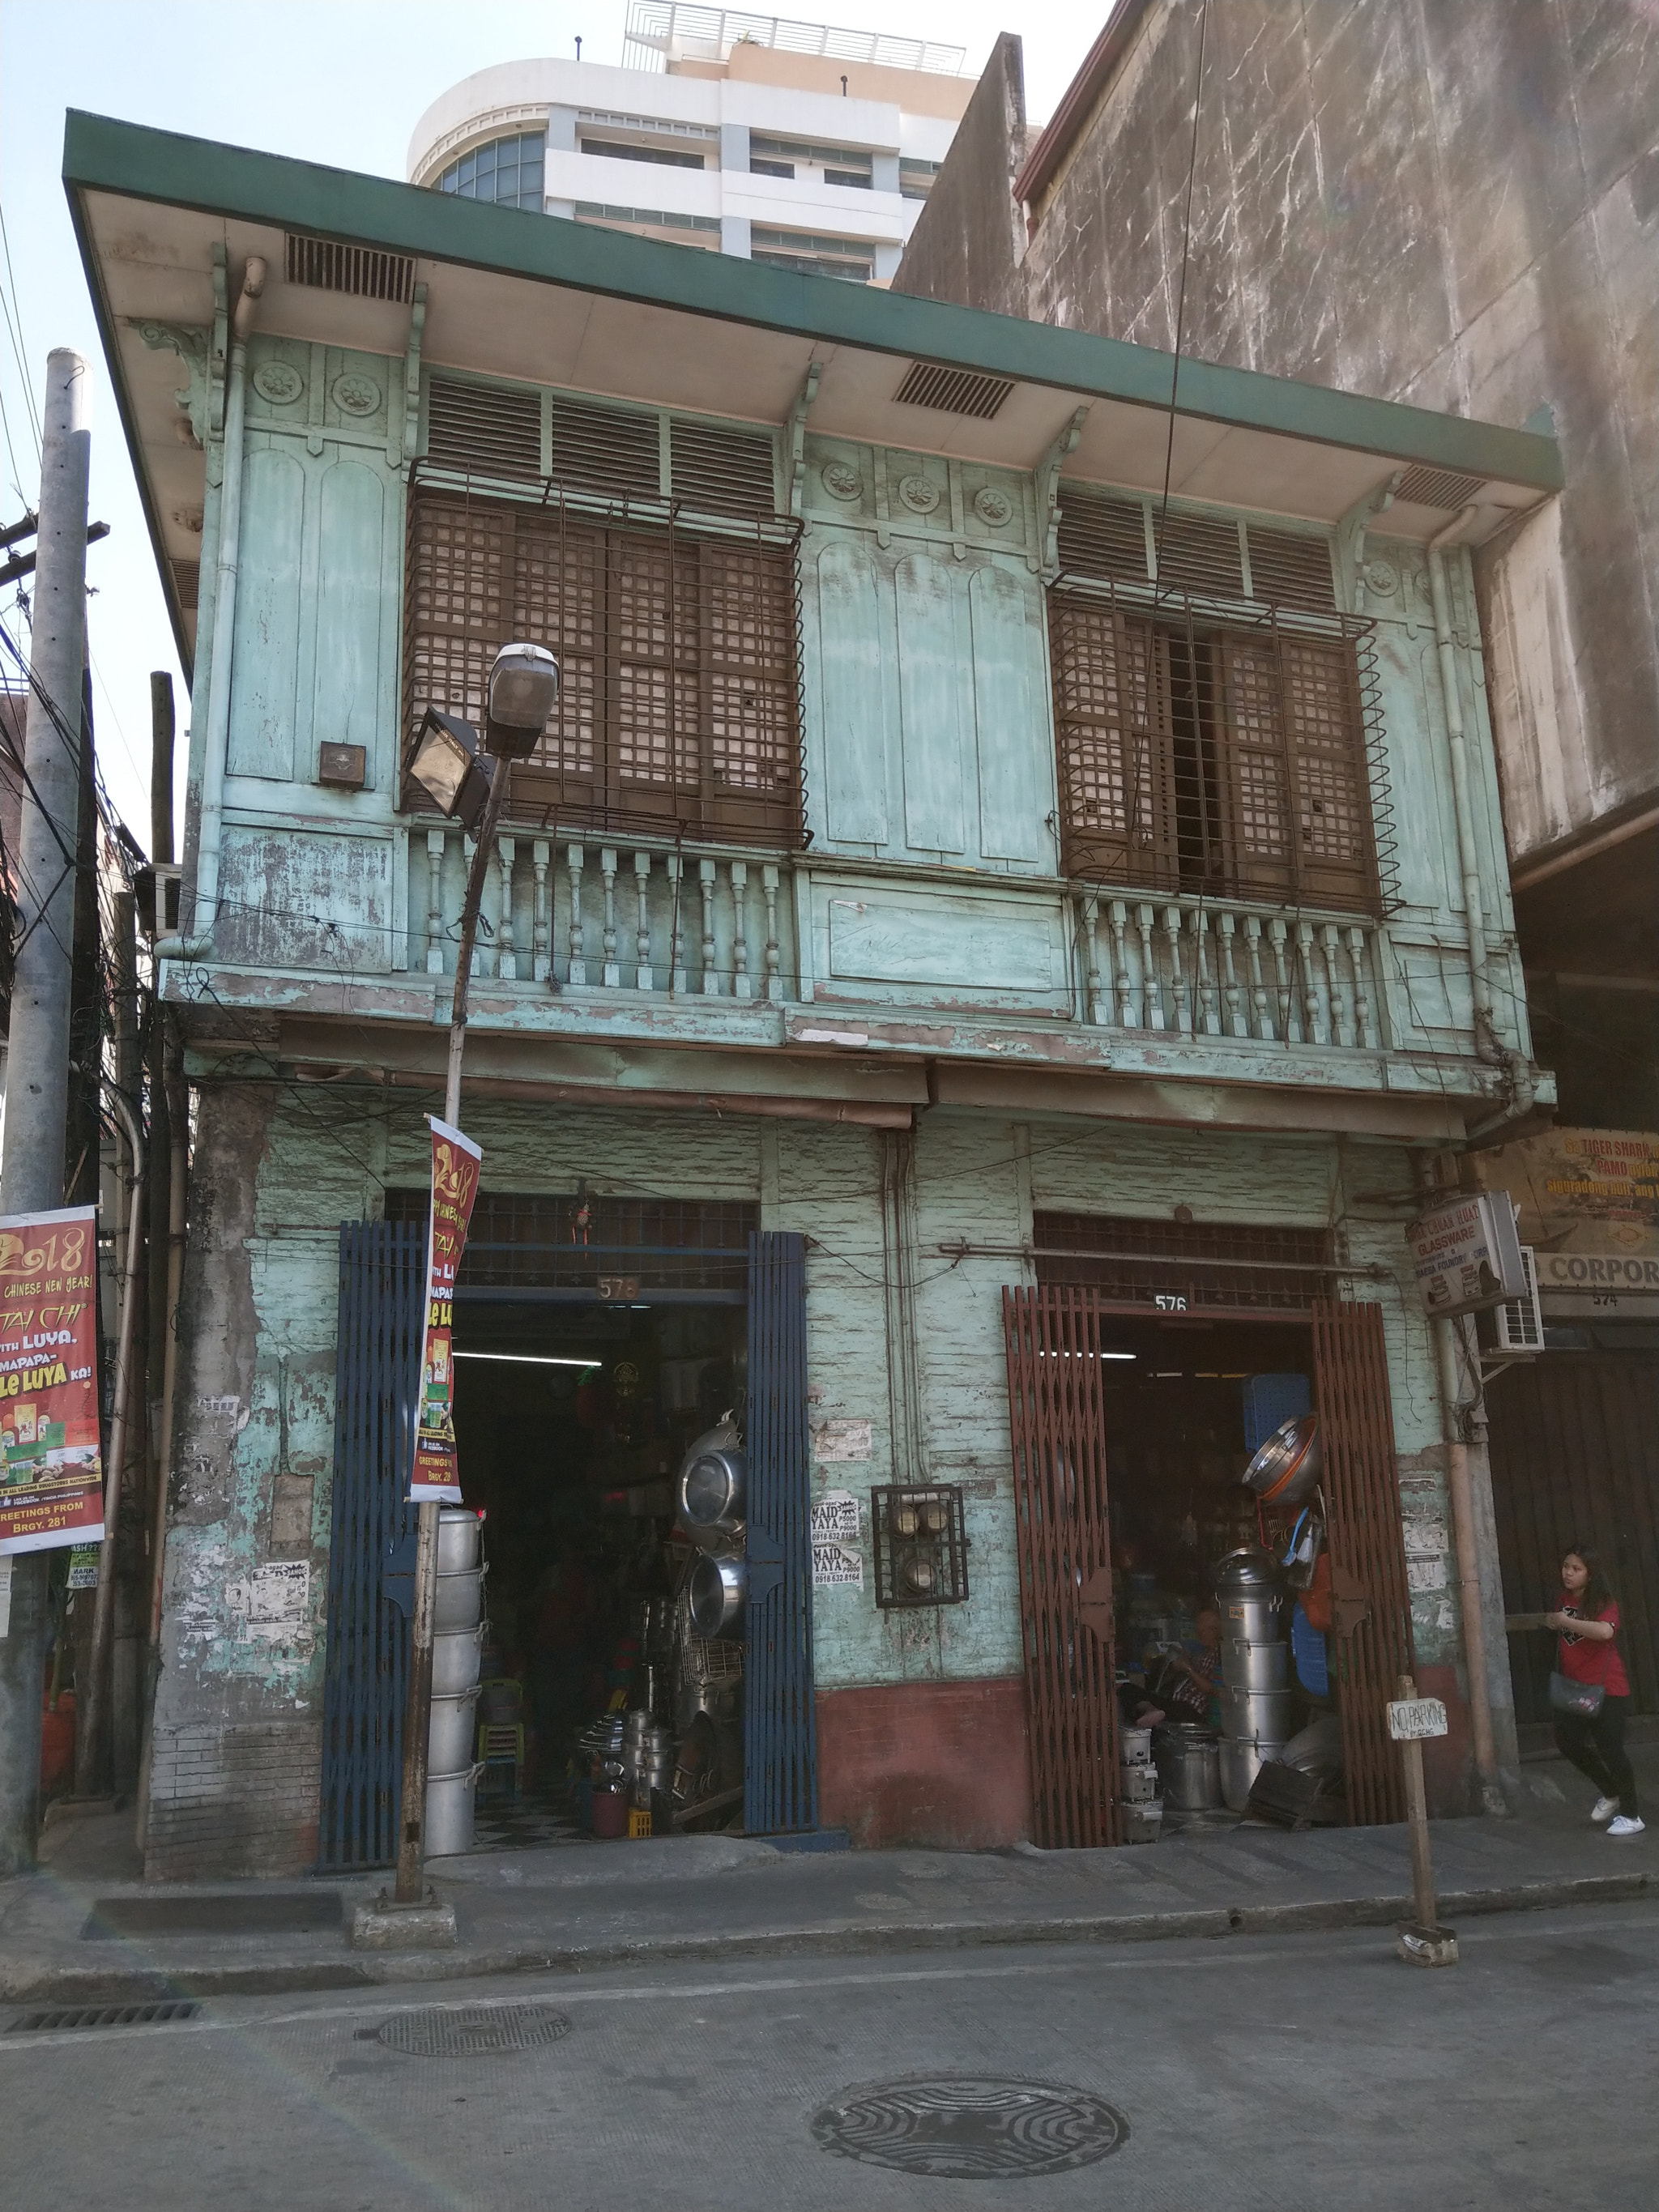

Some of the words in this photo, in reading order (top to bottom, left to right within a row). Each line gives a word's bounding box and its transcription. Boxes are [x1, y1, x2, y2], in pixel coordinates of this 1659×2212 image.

[1581, 1139, 1612, 1155] TIGER
[1614, 1140, 1650, 1158] SHARK
[1596, 1159, 1627, 1176] PAMO
[1546, 1178, 1609, 1196] siguradong
[1418, 1225, 1476, 1257] GLASSWARE
[4, 1281, 42, 1298] CHINESE
[45, 1276, 62, 1294] NEW
[66, 1274, 93, 1293] YEAR!
[1155, 1295, 1187, 1311] 576
[1593, 1295, 1618, 1306] 574
[0, 1309, 35, 1335] TAI
[0, 1342, 19, 1352] ITH
[23, 1330, 78, 1349] LUYA,
[70, 1366, 92, 1381] KA!
[53, 1502, 83, 1513] FROM
[811, 1507, 838, 1519] MAID
[13, 1521, 45, 1533] BRGY.
[48, 1515, 66, 1528] 281
[811, 1518, 839, 1530] YAYA
[812, 1532, 827, 1541] 0918
[813, 1548, 842, 1561] MAID
[814, 1559, 842, 1571] YAYA
[815, 1575, 831, 1583] 0918
[844, 1573, 860, 1581] 8164
[1391, 1703, 1408, 1732] NO
[1408, 1703, 1447, 1728] PARKING
